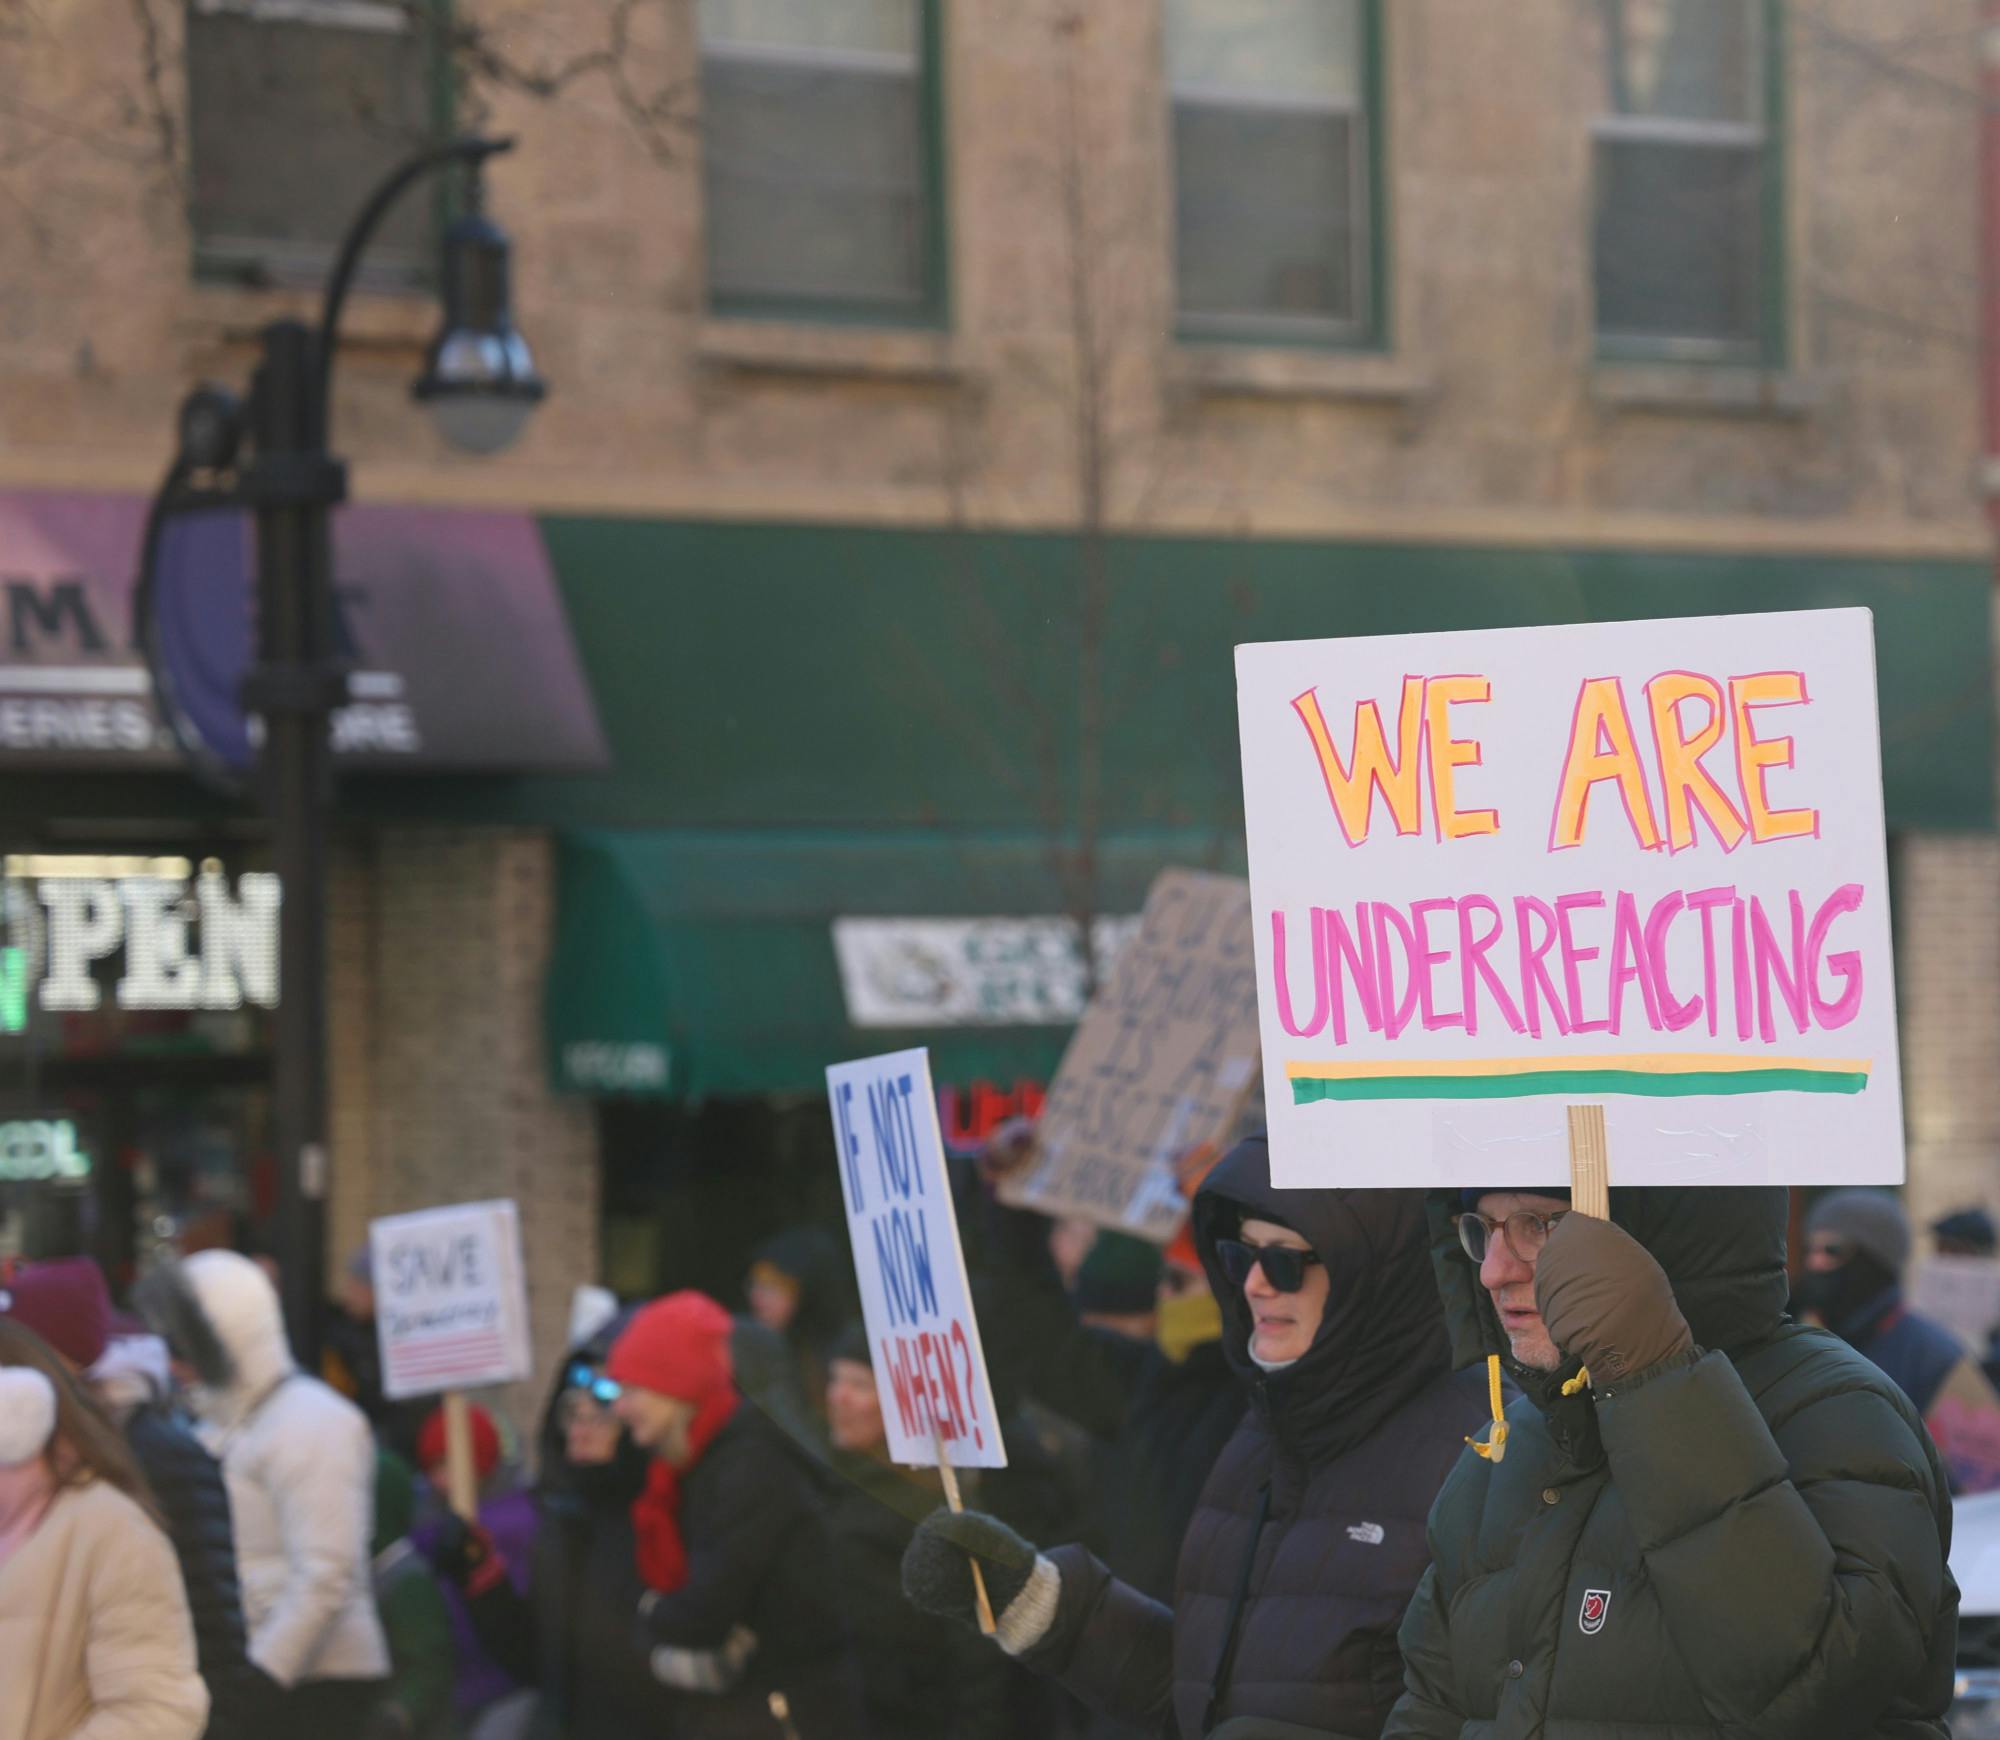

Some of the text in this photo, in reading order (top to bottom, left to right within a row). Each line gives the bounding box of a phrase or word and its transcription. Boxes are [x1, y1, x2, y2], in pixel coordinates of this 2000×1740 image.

[1290, 670, 1820, 856] WE ARE
[1271, 883, 1864, 1046] UNDERREACTING
[835, 1081, 865, 1215] IF
[867, 1073, 925, 1202] NOT
[388, 1233, 481, 1296] SAVE
[872, 1206, 939, 1328] NOW
[881, 1318, 983, 1451] WHEN?
